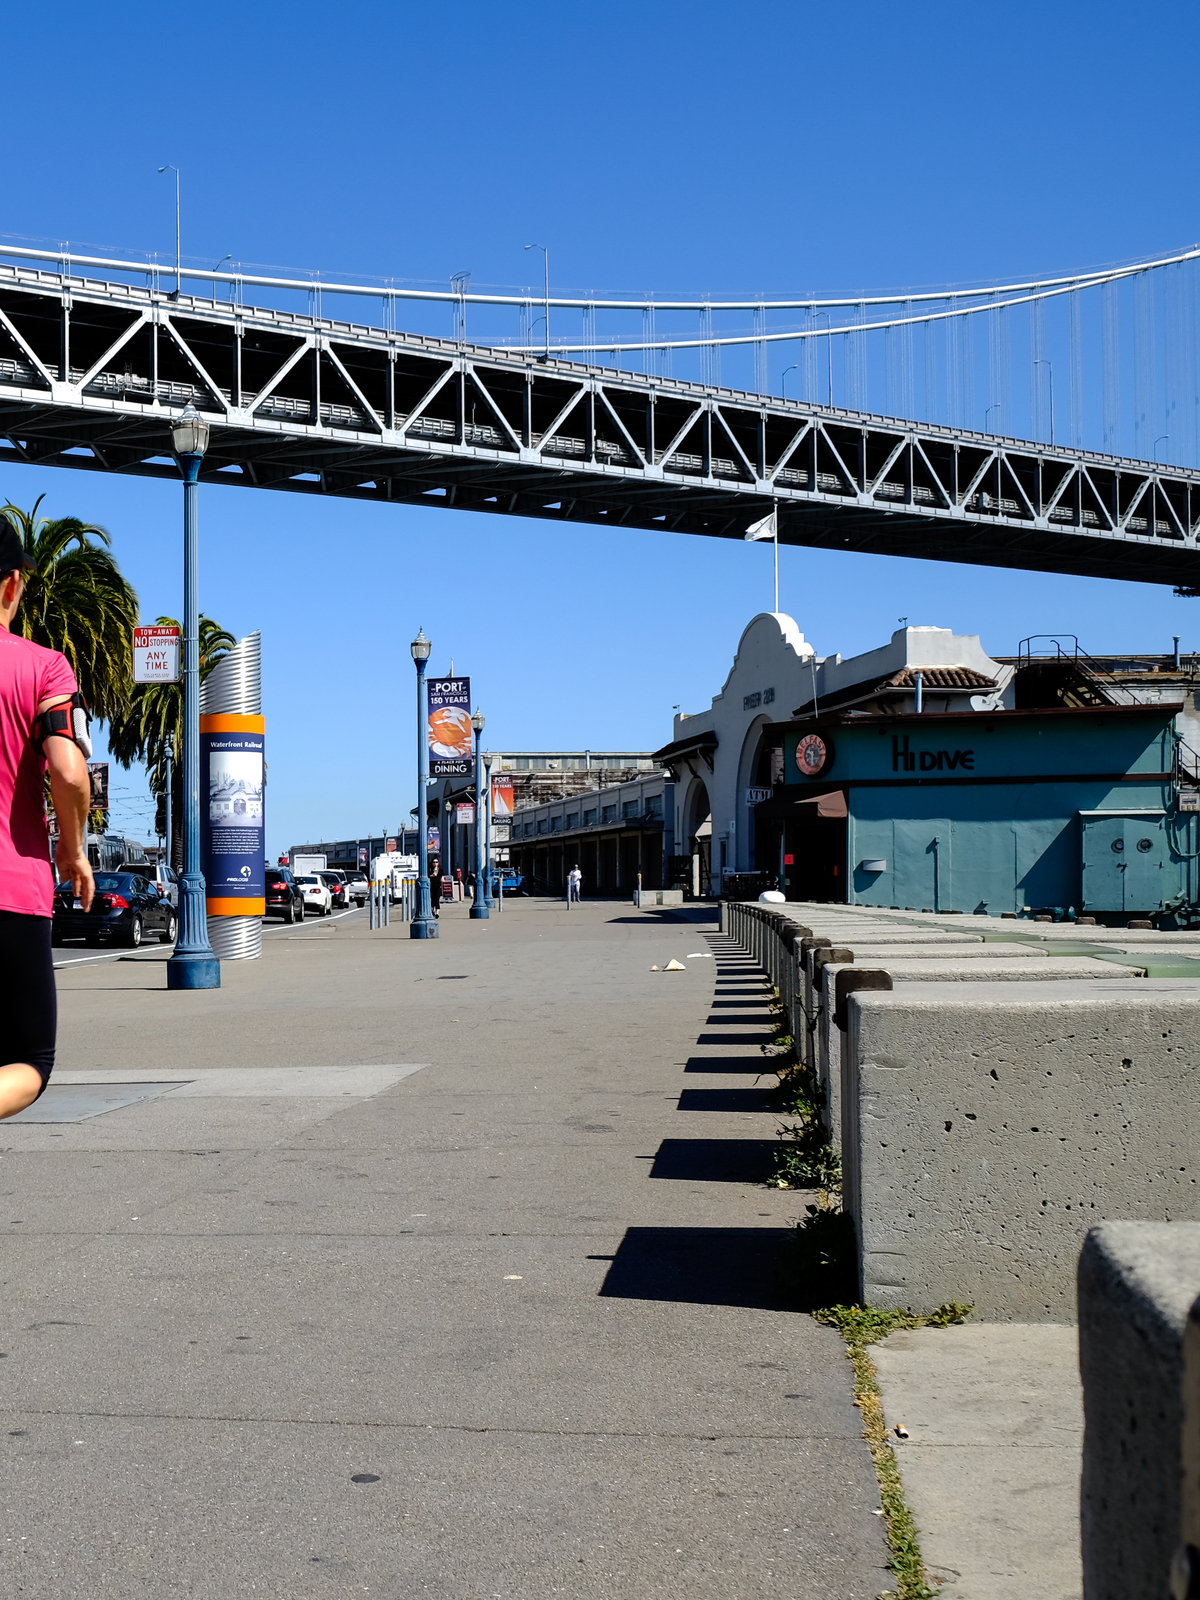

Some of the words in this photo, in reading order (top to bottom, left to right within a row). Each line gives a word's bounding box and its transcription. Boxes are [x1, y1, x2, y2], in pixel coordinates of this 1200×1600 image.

[135, 636, 148, 646] NO
[150, 638, 179, 646] STOPPING
[147, 652, 166, 660] ANY
[145, 662, 168, 670] TIME
[436, 682, 463, 692] PORT
[797, 735, 826, 754] BELFAST
[920, 750, 974, 771] DIVE
[435, 764, 467, 773] DINING
[748, 790, 768, 800] ATM
